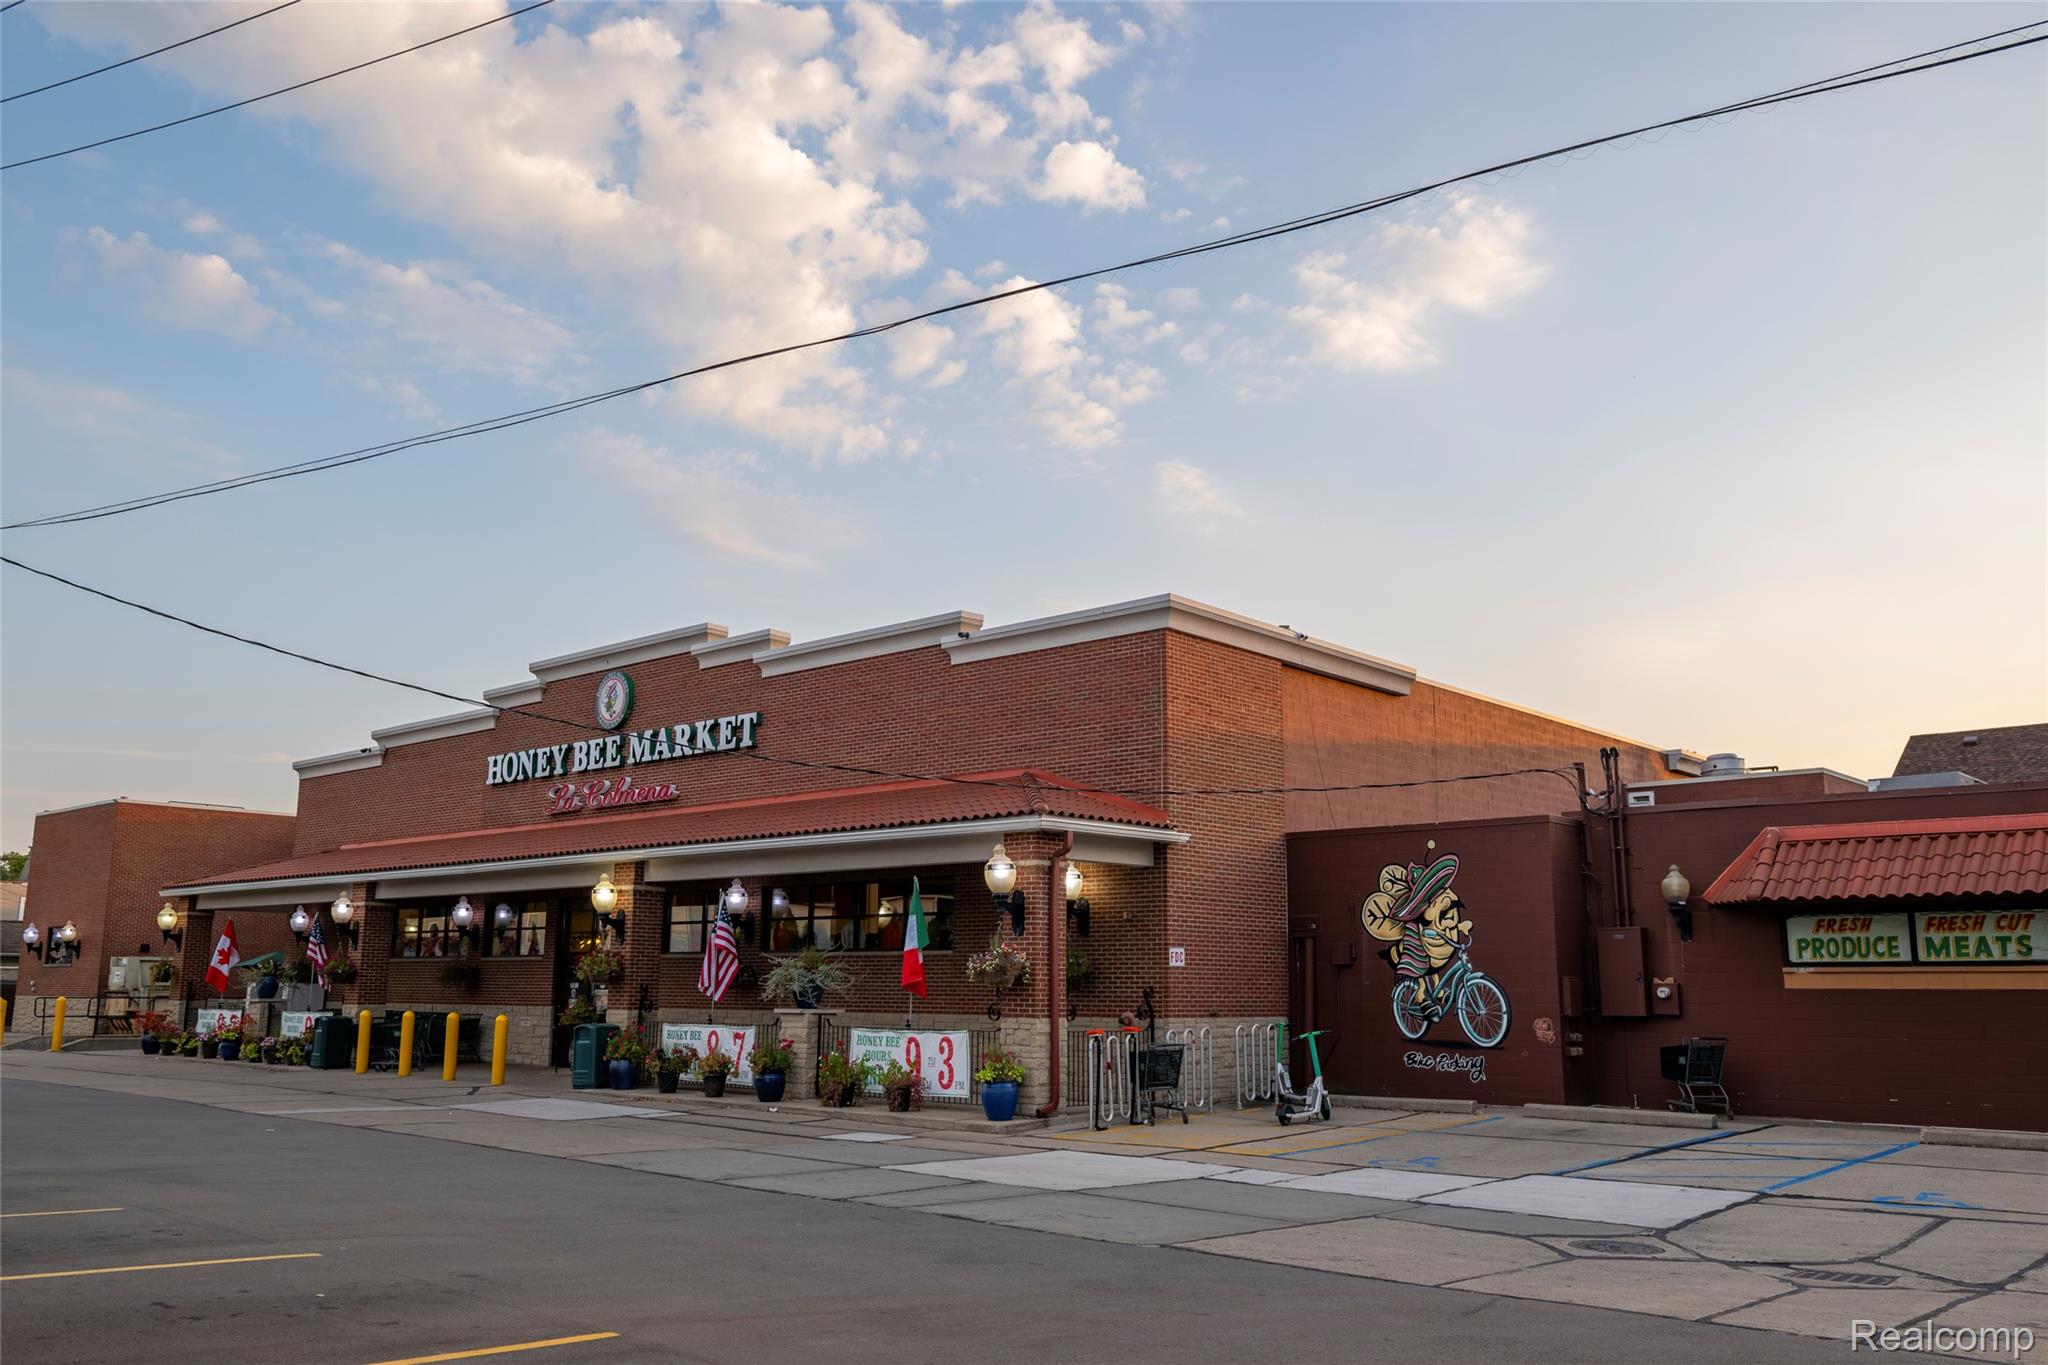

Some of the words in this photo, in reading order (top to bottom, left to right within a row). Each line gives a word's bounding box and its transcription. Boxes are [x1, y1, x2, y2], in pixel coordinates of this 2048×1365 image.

[486, 744, 568, 784] HONEY
[572, 735, 622, 772] BEE
[628, 712, 758, 764] MARKET
[544, 783, 582, 815] La
[581, 777, 680, 808] Colmena
[1812, 916, 1873, 933] FRESH
[1923, 914, 1986, 932] FRESH
[1993, 913, 2036, 931] CUT
[1795, 935, 1900, 959] PRODUCE
[1923, 934, 2033, 958] MEATS
[666, 1029, 689, 1040] HONEY
[689, 1030, 702, 1041] BEE
[856, 1034, 884, 1047] HONEY
[886, 1036, 900, 1048] BEE
[938, 1036, 954, 1090] 3
[1403, 1051, 1434, 1069] Bike
[1436, 1053, 1486, 1083] Parking
